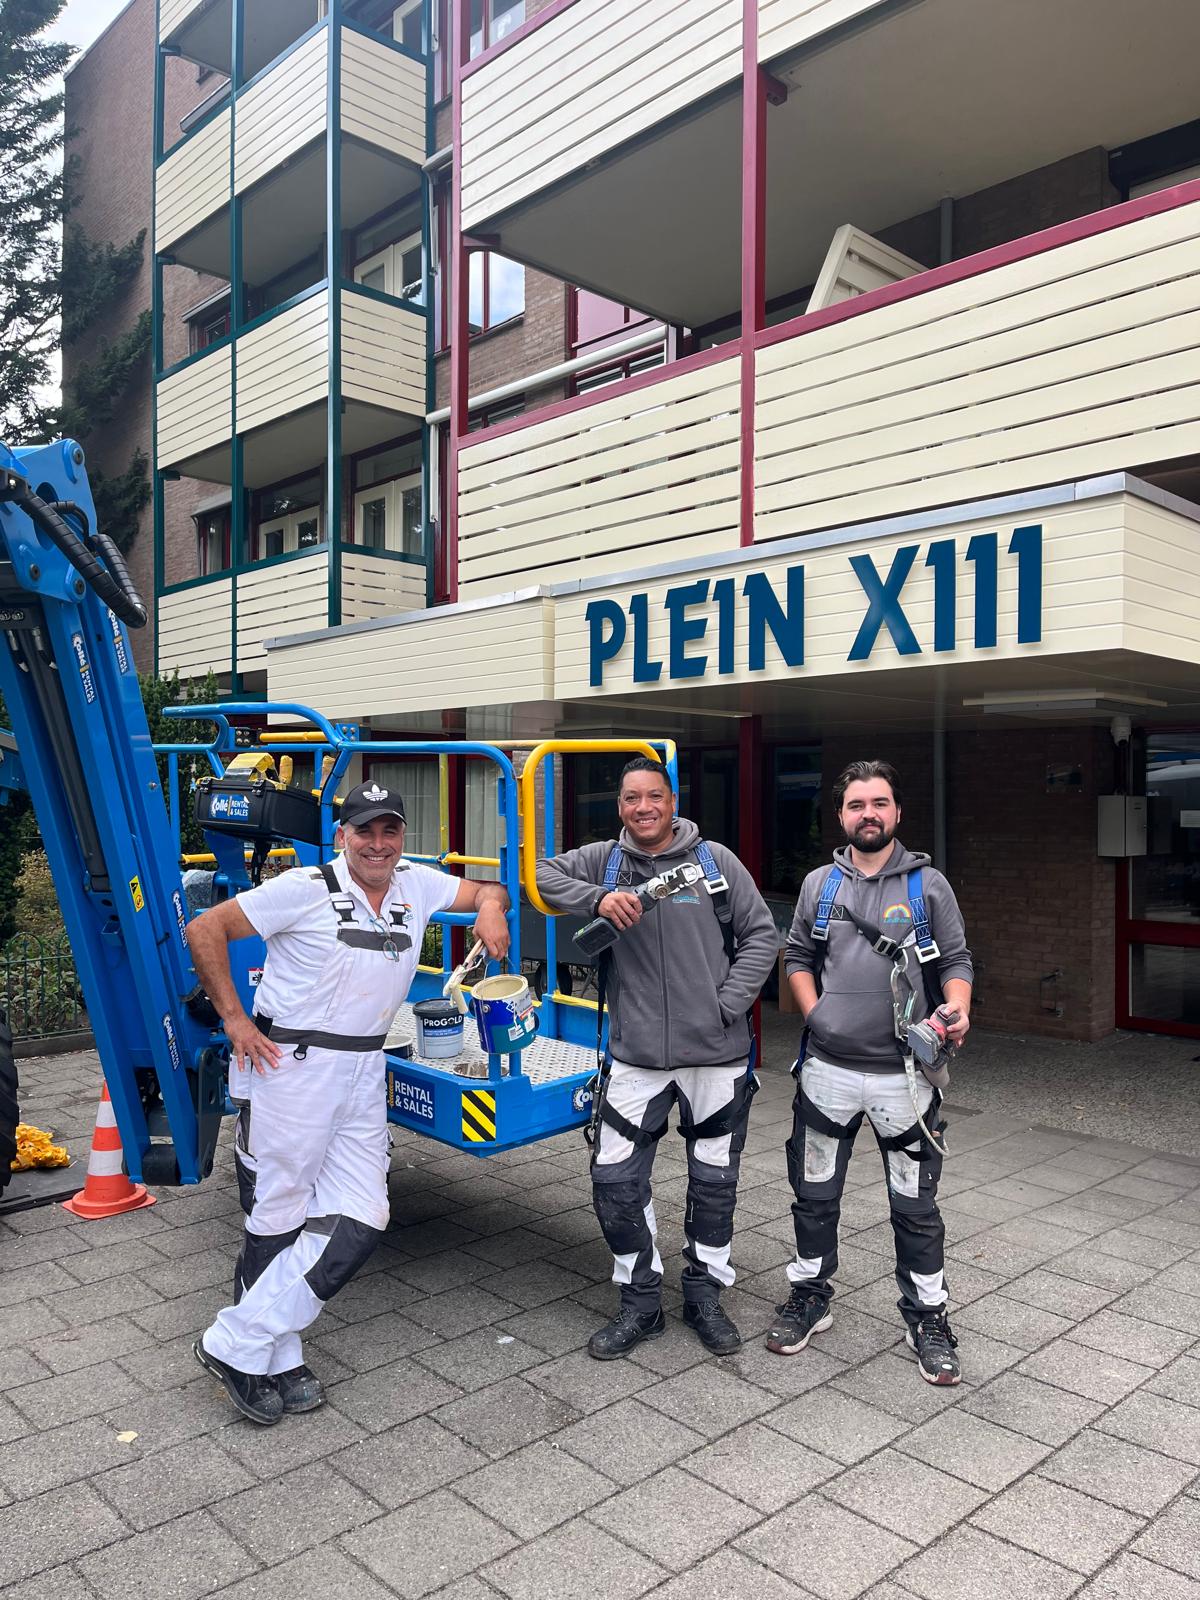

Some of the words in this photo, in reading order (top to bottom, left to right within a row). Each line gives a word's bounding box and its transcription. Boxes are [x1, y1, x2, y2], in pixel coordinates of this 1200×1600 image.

[585, 565, 805, 687] PLEIN
[234, 809, 249, 817] SALES
[394, 1080, 433, 1105] RENTAL
[395, 1094, 402, 1108] &
[403, 1097, 434, 1119] SALES
